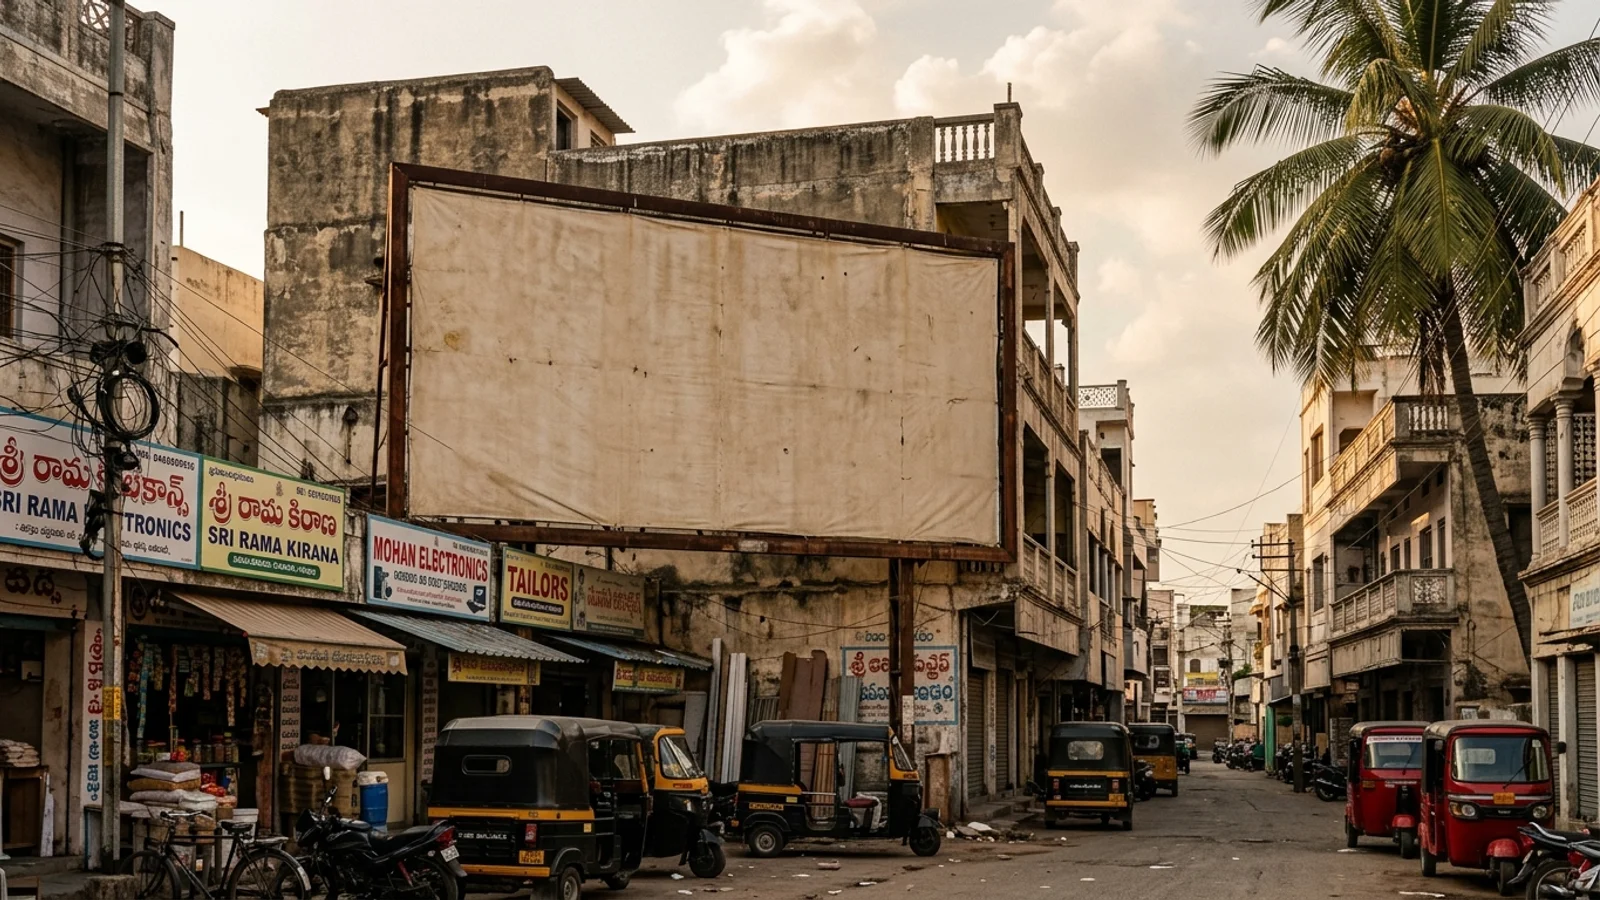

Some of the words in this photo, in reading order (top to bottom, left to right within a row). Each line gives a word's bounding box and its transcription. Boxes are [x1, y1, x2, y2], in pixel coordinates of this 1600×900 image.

[33, 454, 91, 489] రామ
[0, 490, 21, 514] RI
[28, 494, 79, 523] RAMA
[238, 496, 284, 525] రామ
[208, 526, 234, 547] SRI
[239, 530, 283, 556] RAMA
[287, 540, 340, 565] KIRANA
[373, 535, 416, 568] MOHAN
[419, 546, 489, 582] ELECTRONICS
[507, 565, 569, 602] TAILORS
